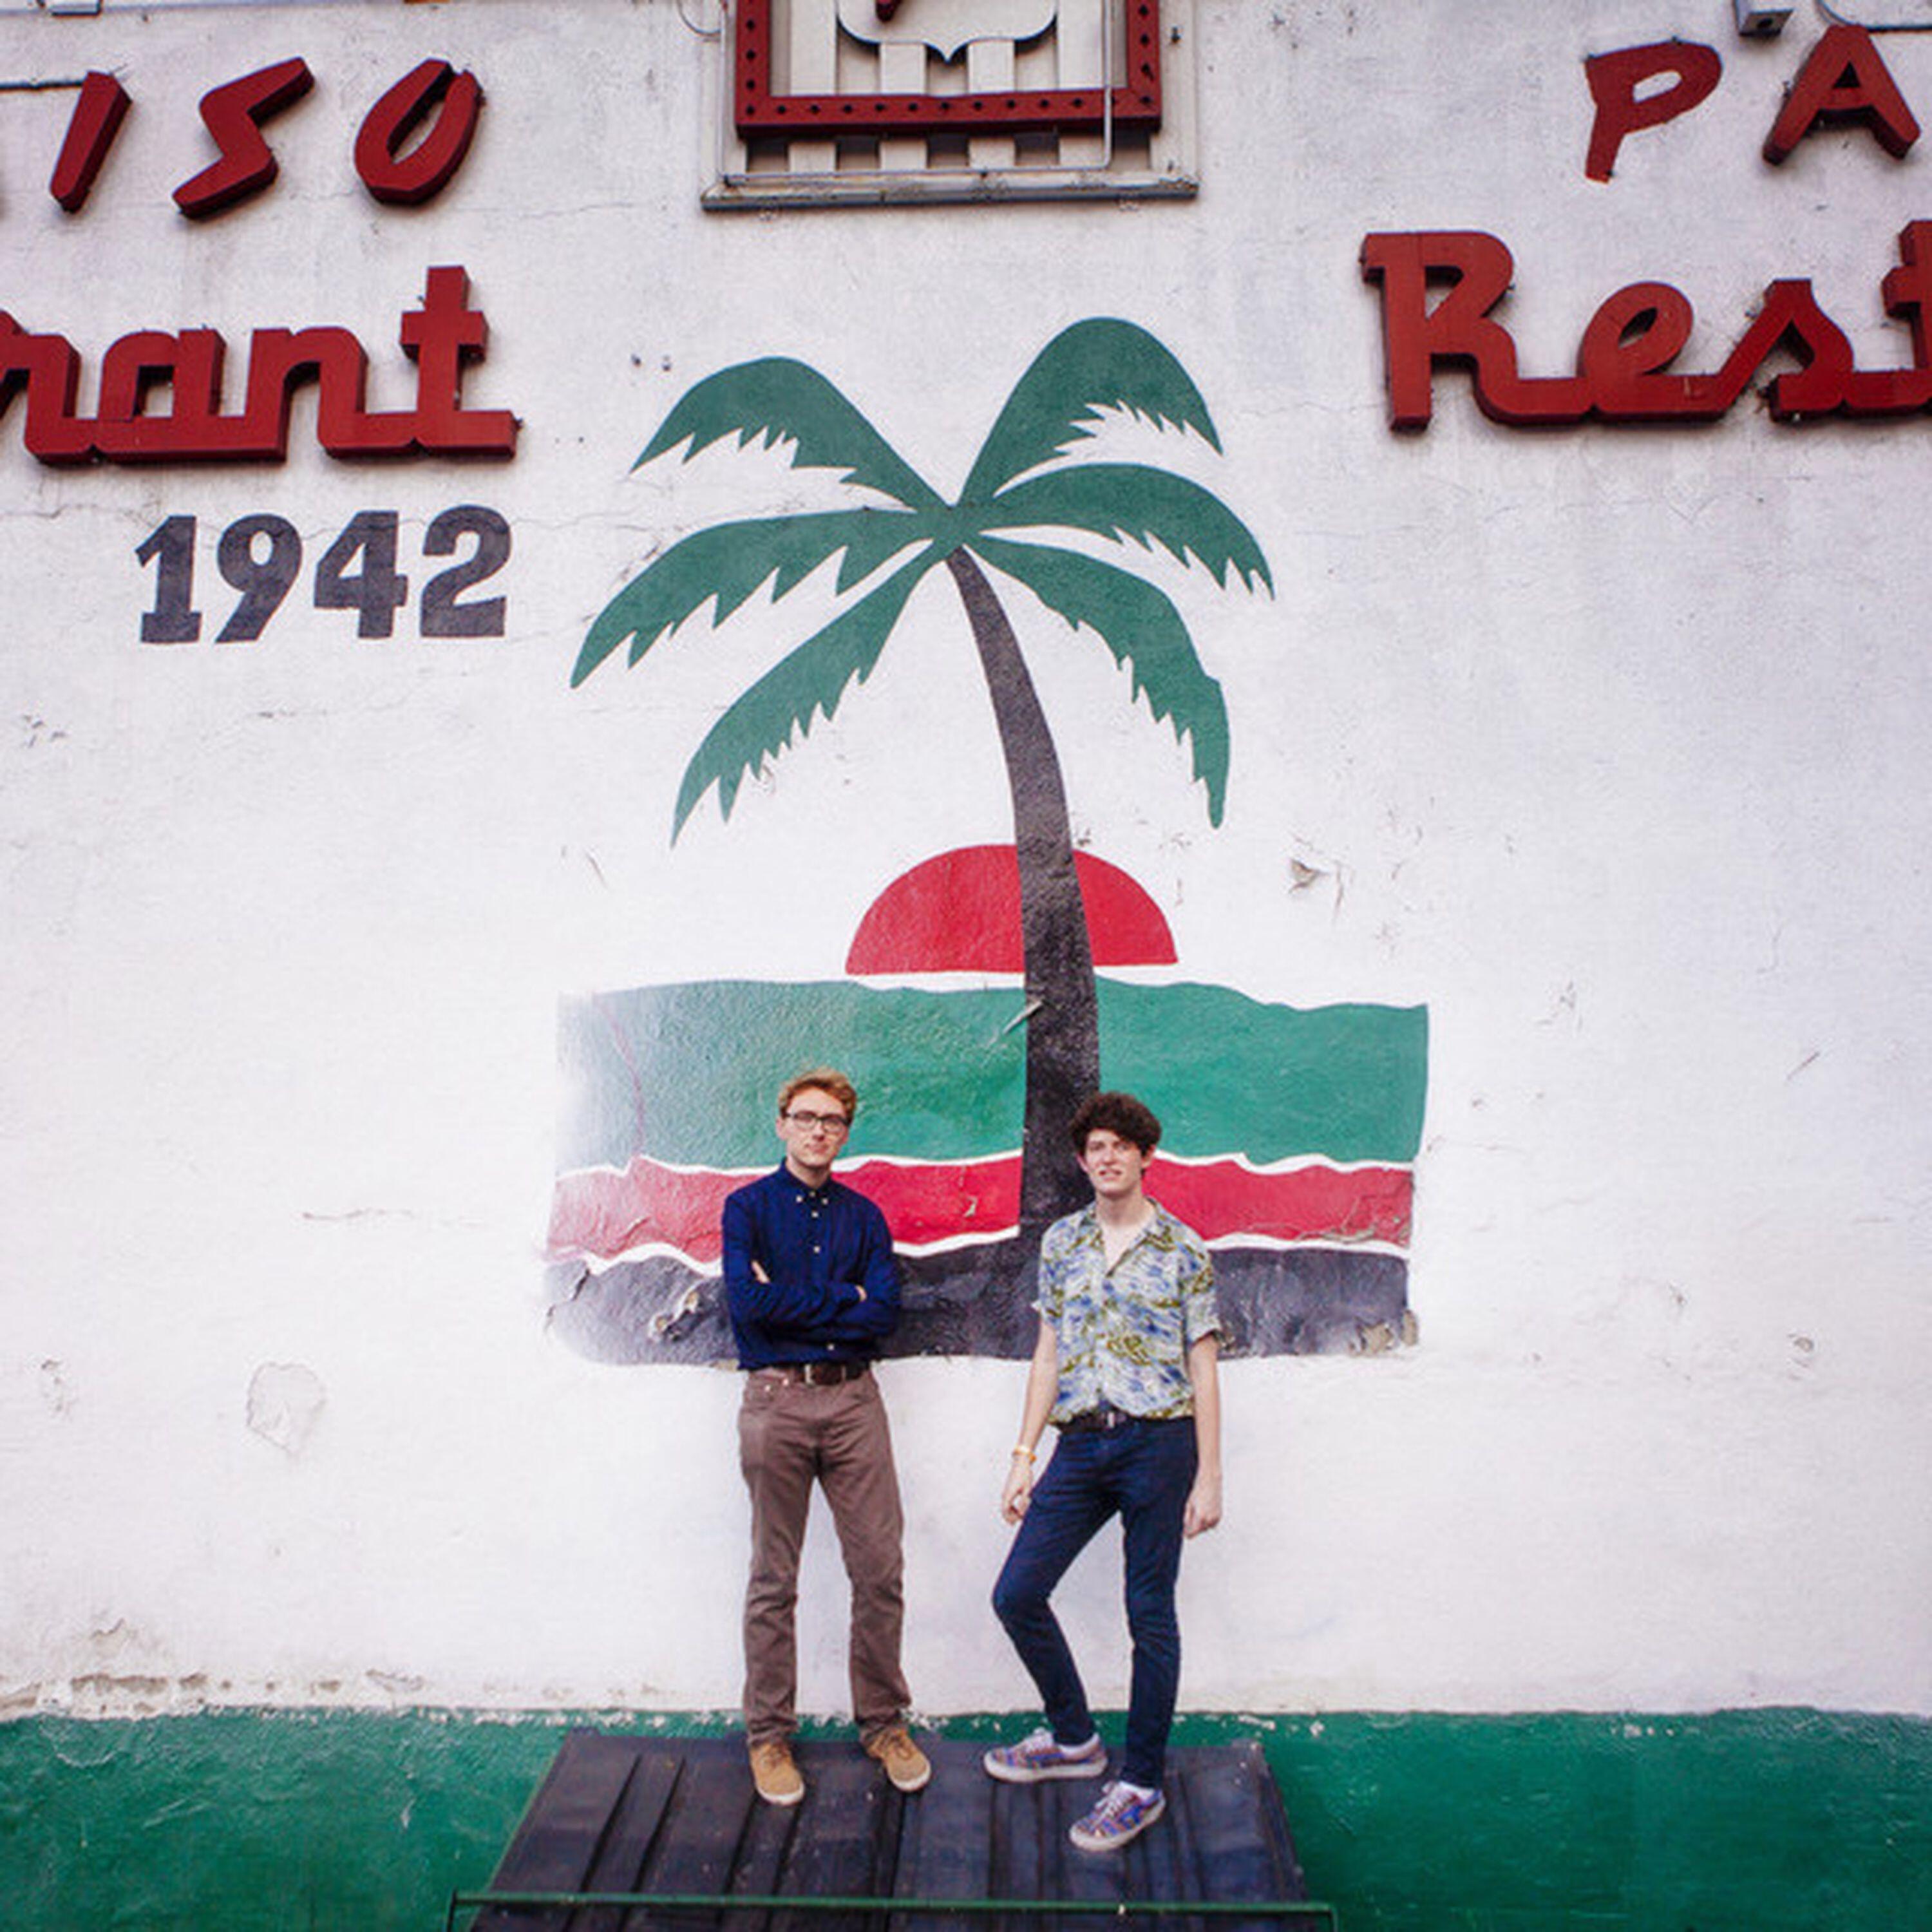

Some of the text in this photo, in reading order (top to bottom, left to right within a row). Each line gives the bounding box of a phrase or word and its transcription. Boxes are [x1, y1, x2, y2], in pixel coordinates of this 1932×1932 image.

[50, 57, 484, 218] ISO
[1584, 24, 1921, 184] PA
[135, 504, 513, 644] 1942
